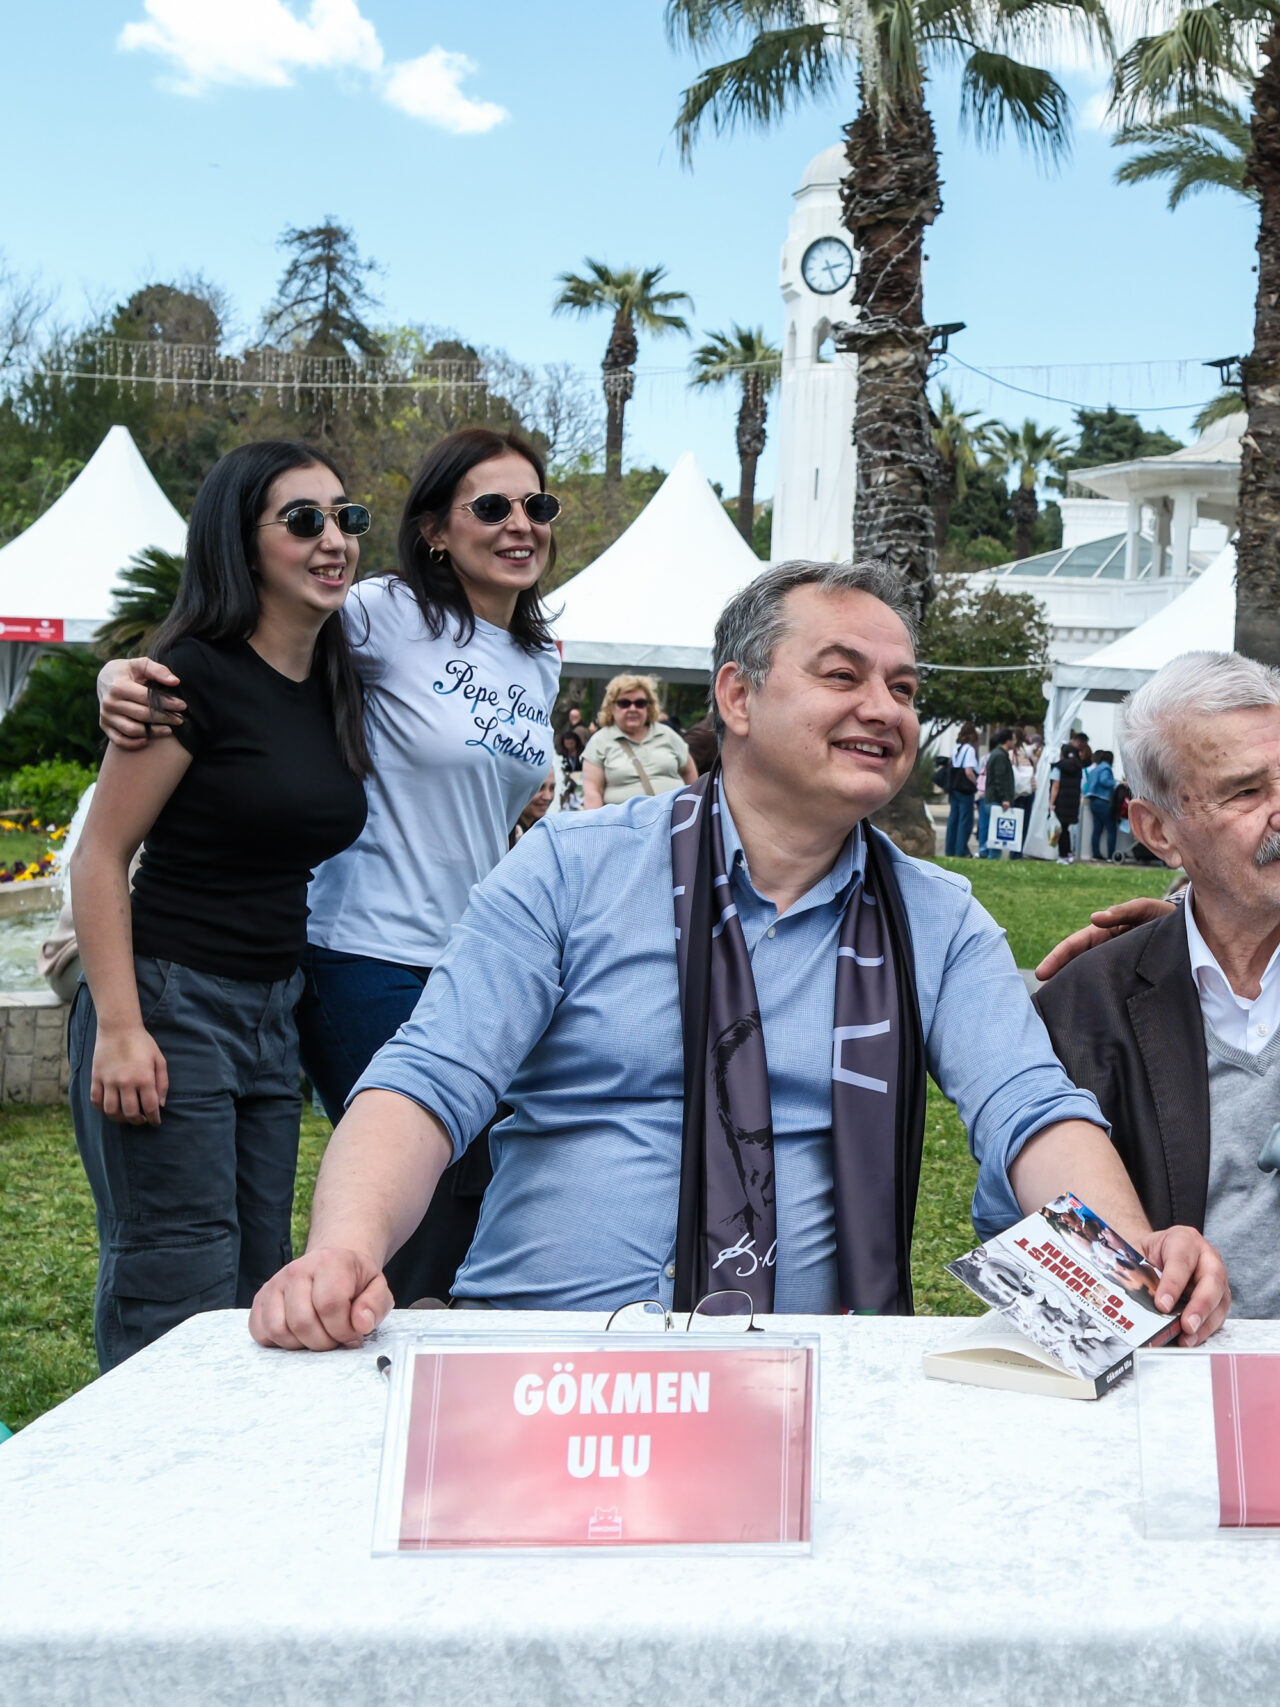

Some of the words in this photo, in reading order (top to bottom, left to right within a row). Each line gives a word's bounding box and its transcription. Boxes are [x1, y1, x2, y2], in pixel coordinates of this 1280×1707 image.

[433, 659, 499, 714] Pepe
[496, 684, 549, 728] Jeans
[465, 716, 546, 767] London
[513, 1362, 711, 1416] GÖKMEN
[567, 1435, 651, 1479] ULU
